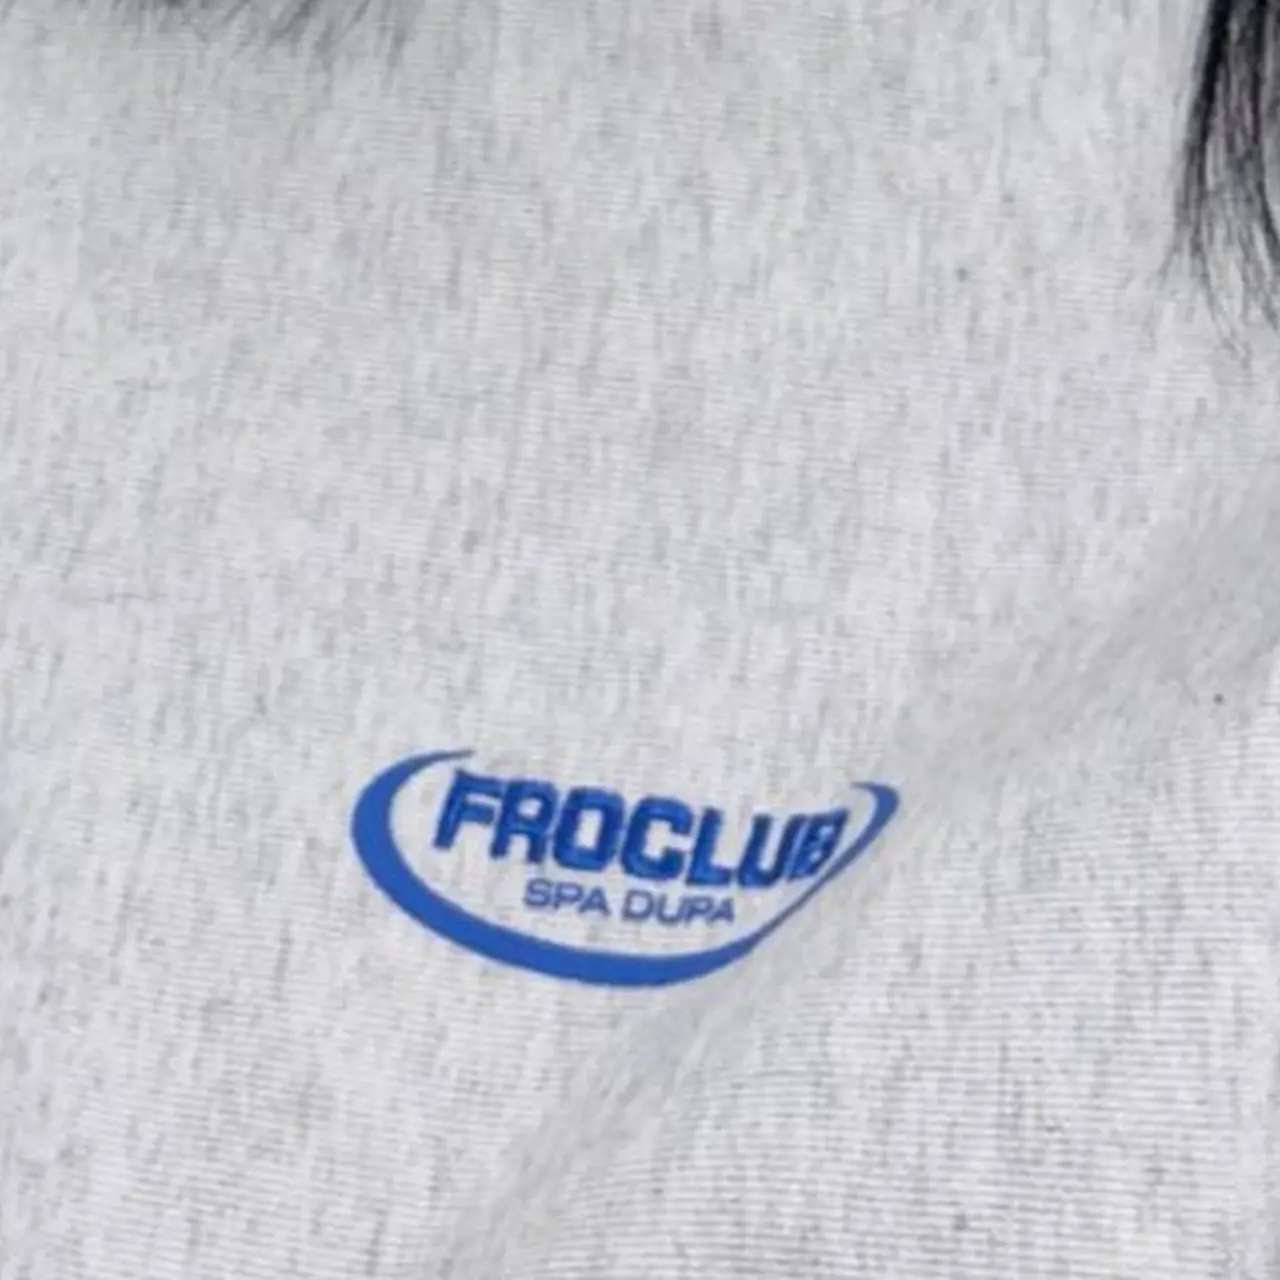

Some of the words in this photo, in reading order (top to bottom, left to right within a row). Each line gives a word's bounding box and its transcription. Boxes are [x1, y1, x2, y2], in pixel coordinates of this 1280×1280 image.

[434, 768, 848, 888] FROCLUB
[524, 877, 610, 916] SPA
[623, 888, 735, 926] DUPA
